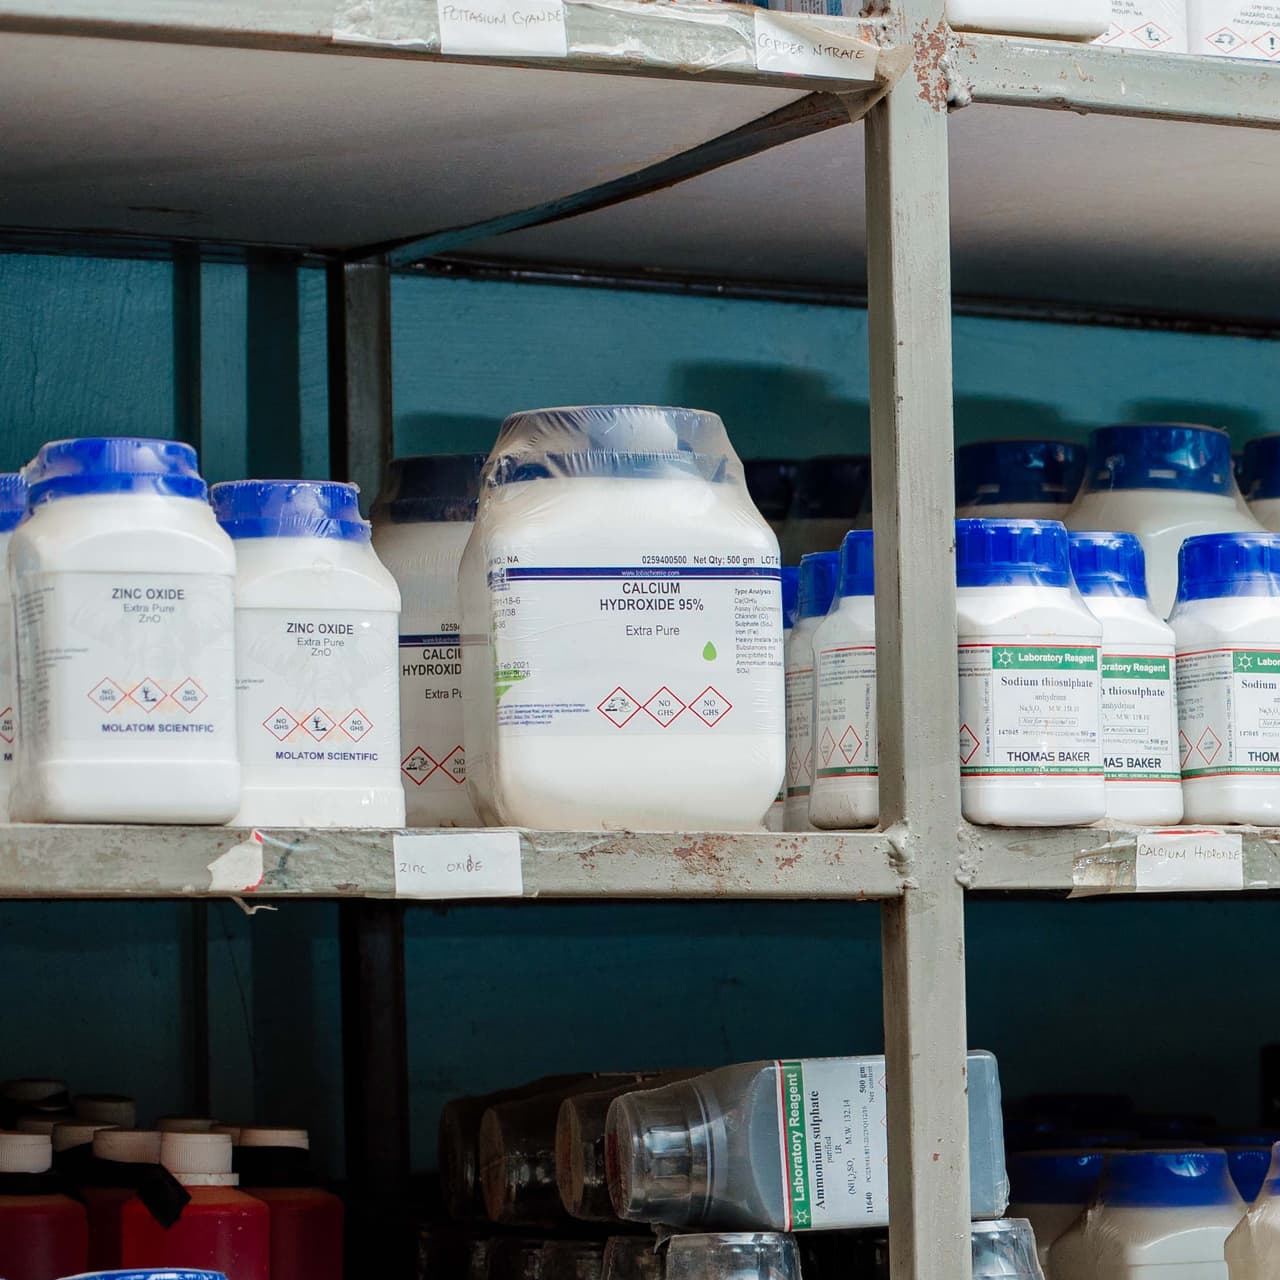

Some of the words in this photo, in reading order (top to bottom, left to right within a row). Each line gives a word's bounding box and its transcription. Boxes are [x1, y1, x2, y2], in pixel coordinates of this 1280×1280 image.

[112, 588, 142, 600] ZINC
[146, 589, 185, 600] OXIDE
[622, 582, 681, 594] CALCIUM
[123, 603, 148, 613] Extra
[151, 604, 175, 614] Pure
[600, 598, 675, 611] HYDROXIDE
[678, 598, 704, 611] 95%
[287, 622, 315, 634] ZINC
[318, 623, 354, 635] OXIDE
[626, 625, 652, 637] Extra
[656, 625, 680, 637] Pure
[1018, 653, 1062, 665] Laboratory
[1064, 653, 1095, 665] Reagent
[1001, 677, 1038, 688] Sodium
[1041, 677, 1093, 690] thiosulphate
[1241, 679, 1278, 691] Sodium
[102, 723, 155, 733] MOLATOM
[158, 723, 214, 733] SCIENTIFIC
[275, 751, 324, 761] MOLATOM
[327, 751, 378, 762] SCIENTIFIC
[1007, 751, 1055, 763] THOMAS
[1058, 751, 1090, 763] BAKER
[1126, 757, 1161, 769] BAKER
[788, 1072, 801, 1125] Reagent
[808, 1089, 822, 1138] sulphate
[792, 1127, 807, 1203] Laboratory
[811, 1141, 826, 1210] Ammonium
